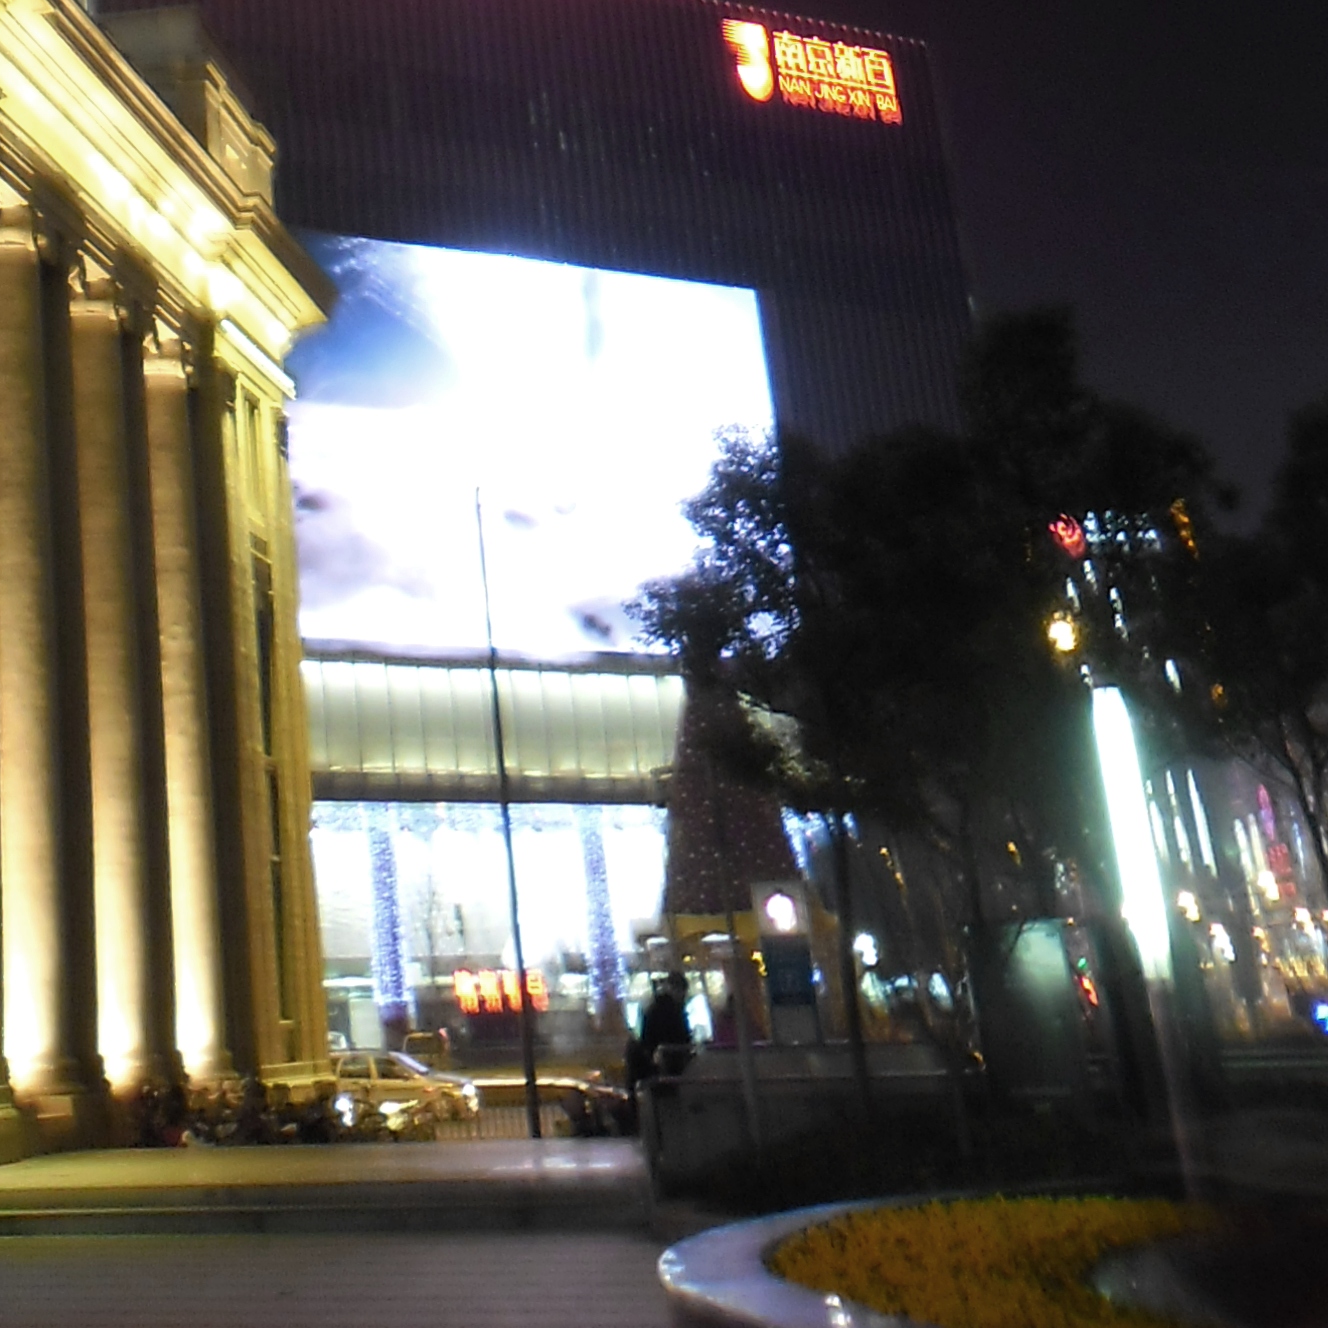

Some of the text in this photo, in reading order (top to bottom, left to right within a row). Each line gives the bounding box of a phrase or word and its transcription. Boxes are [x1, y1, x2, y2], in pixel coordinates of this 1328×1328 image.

[773, 30, 894, 90] 南京新百
[778, 75, 897, 111] NAN JING XIN BAI
